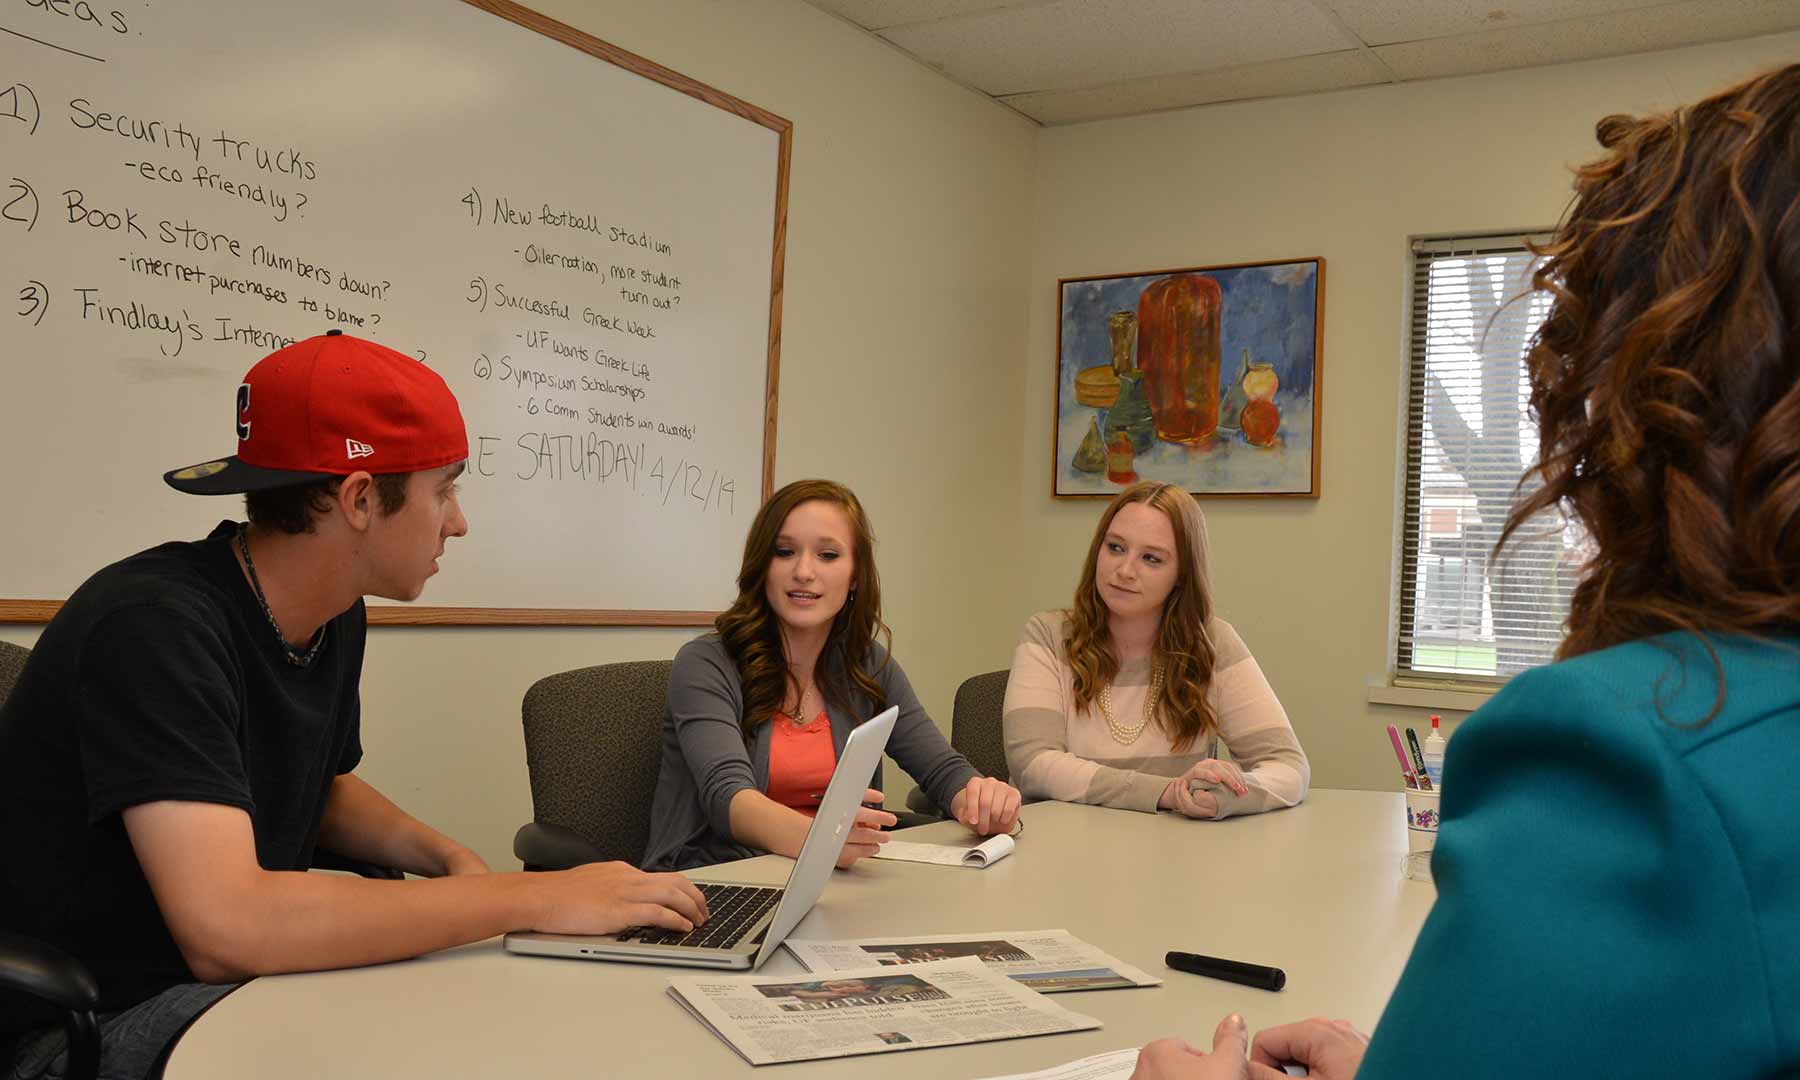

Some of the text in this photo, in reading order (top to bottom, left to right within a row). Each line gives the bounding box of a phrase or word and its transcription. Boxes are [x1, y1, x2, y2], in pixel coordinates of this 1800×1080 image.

[70, 98, 200, 161] Security
[212, 130, 317, 180] trucks
[461, 186, 482, 226] 4)
[493, 197, 532, 226] New
[538, 203, 602, 236] football
[2, 177, 391, 301] 2) Book store numbers down?
[210, 274, 288, 304] purchases
[298, 297, 318, 312] to
[610, 265, 635, 280] more
[640, 268, 682, 290] student
[619, 287, 681, 311] turn out?
[18, 280, 49, 326] 3)
[74, 288, 203, 356] Findlay's
[466, 276, 656, 339] 5) Successful Greek Week
[473, 353, 493, 381] 6)
[499, 355, 576, 392] Symposium
[595, 350, 629, 372] Greek
[632, 361, 651, 382] Life
[545, 399, 580, 420] Comm
[658, 422, 696, 441] awards!
[516, 432, 646, 496] SATURDAY!
